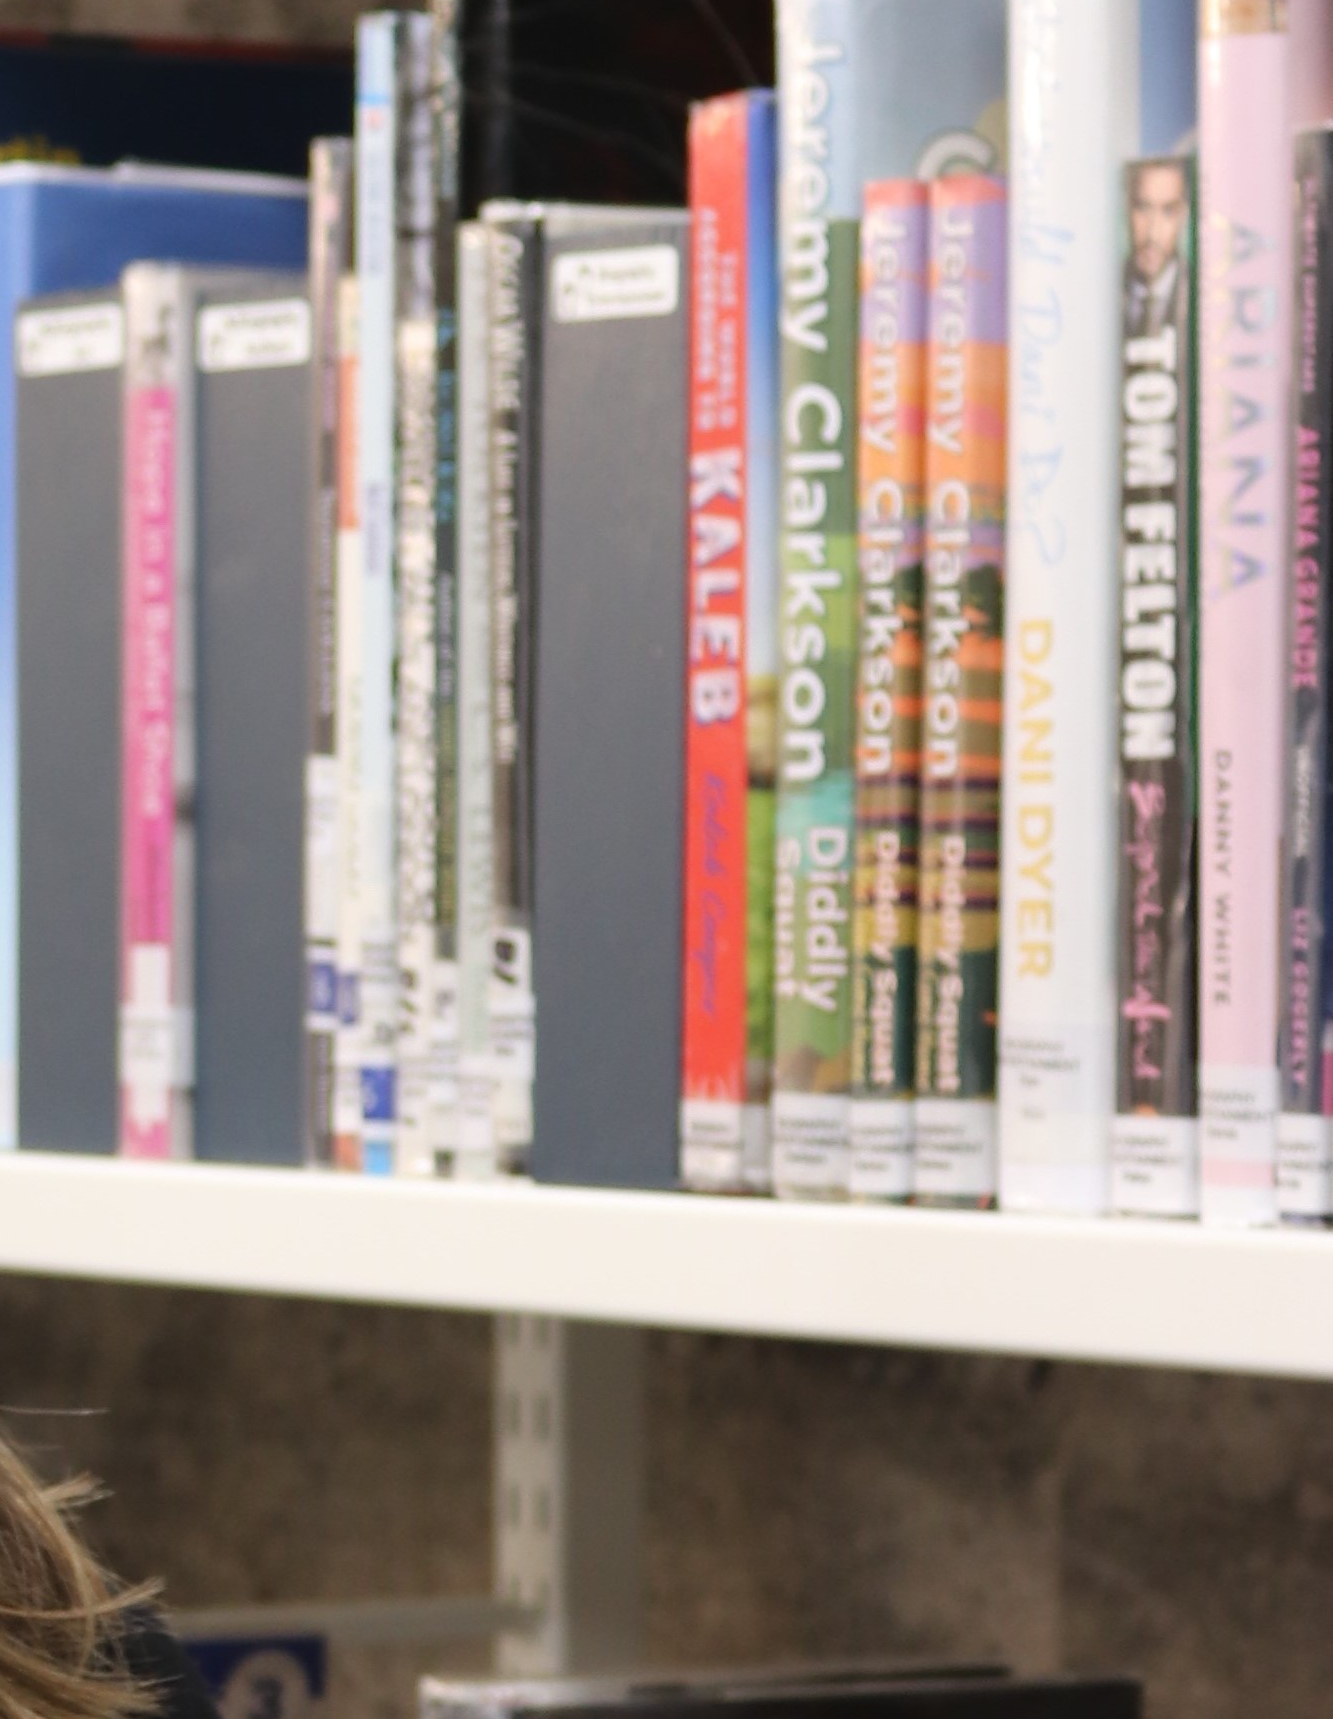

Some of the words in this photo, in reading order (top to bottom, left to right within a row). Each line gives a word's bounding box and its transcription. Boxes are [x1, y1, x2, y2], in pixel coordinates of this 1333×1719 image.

[776, 42, 845, 355] Jeremy
[492, 232, 527, 318] OSCAR
[861, 210, 908, 454] Jeremy
[931, 206, 974, 456] Jeremy
[492, 321, 526, 411] WILDE
[696, 390, 717, 431] TO
[717, 321, 739, 428] WORLD
[1124, 327, 1179, 485] TOM
[1212, 219, 1276, 602] ARIANA
[1295, 425, 1320, 550] ARIANA
[690, 446, 742, 725] KALEB
[783, 379, 845, 782] Clarkson
[863, 477, 906, 776] Clarkson
[933, 477, 973, 778] Clarkson
[1123, 503, 1178, 762] FELTON
[1292, 555, 1319, 690] GRANDE
[141, 603, 176, 715] Ballet
[1018, 616, 1056, 784] DANI
[141, 720, 175, 821] Shoe
[1212, 748, 1234, 878] DANNY
[774, 834, 803, 999] Squat
[799, 825, 849, 1012] Diddly
[870, 829, 900, 962] Diddly
[934, 832, 966, 970] Diddly
[1018, 804, 1056, 980] DYER
[1211, 891, 1234, 1008] WHITE
[870, 967, 898, 1084] Squat
[935, 973, 964, 1093] Squat
